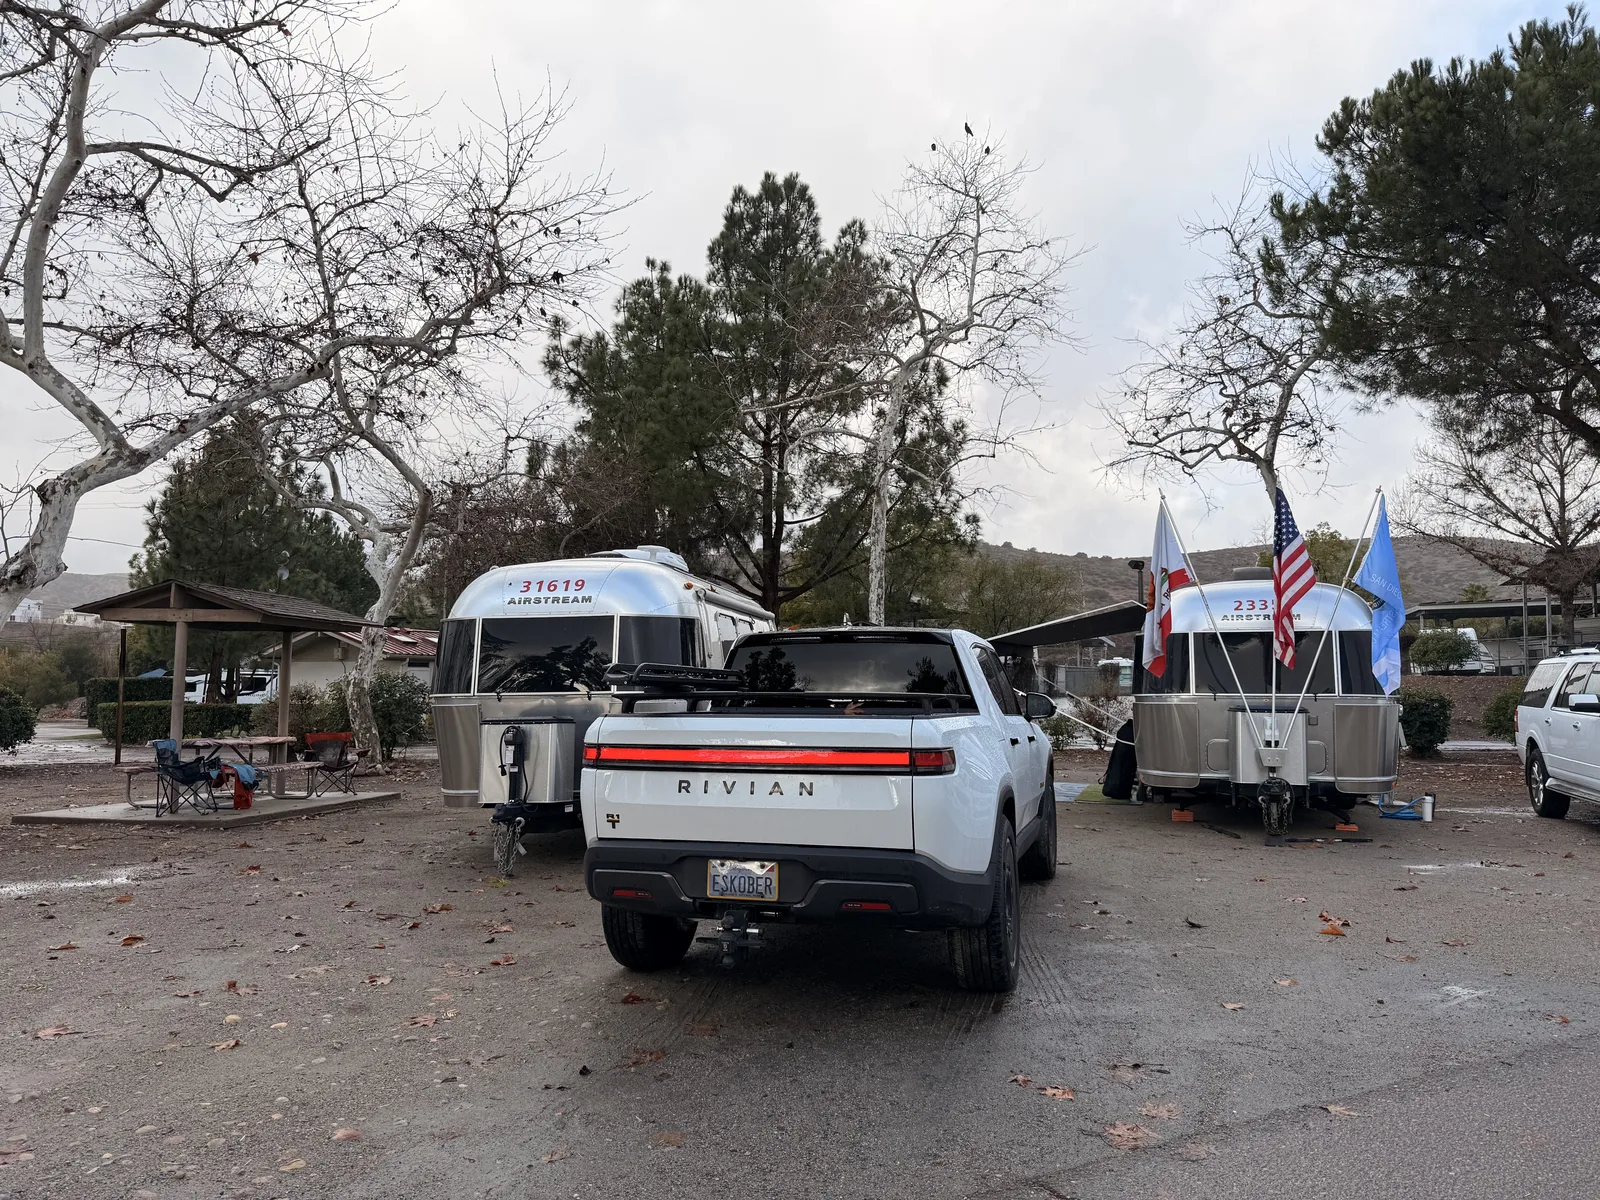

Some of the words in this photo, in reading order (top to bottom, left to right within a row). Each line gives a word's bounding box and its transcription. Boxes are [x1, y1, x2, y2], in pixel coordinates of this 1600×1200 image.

[520, 579, 585, 593] 31619
[1370, 573, 1386, 587] SAN
[507, 595, 592, 605] AIRSTREAM
[1221, 613, 1301, 621] AIRSTRM
[677, 779, 814, 796] RIVIAN
[712, 874, 773, 895] ESKOBER
